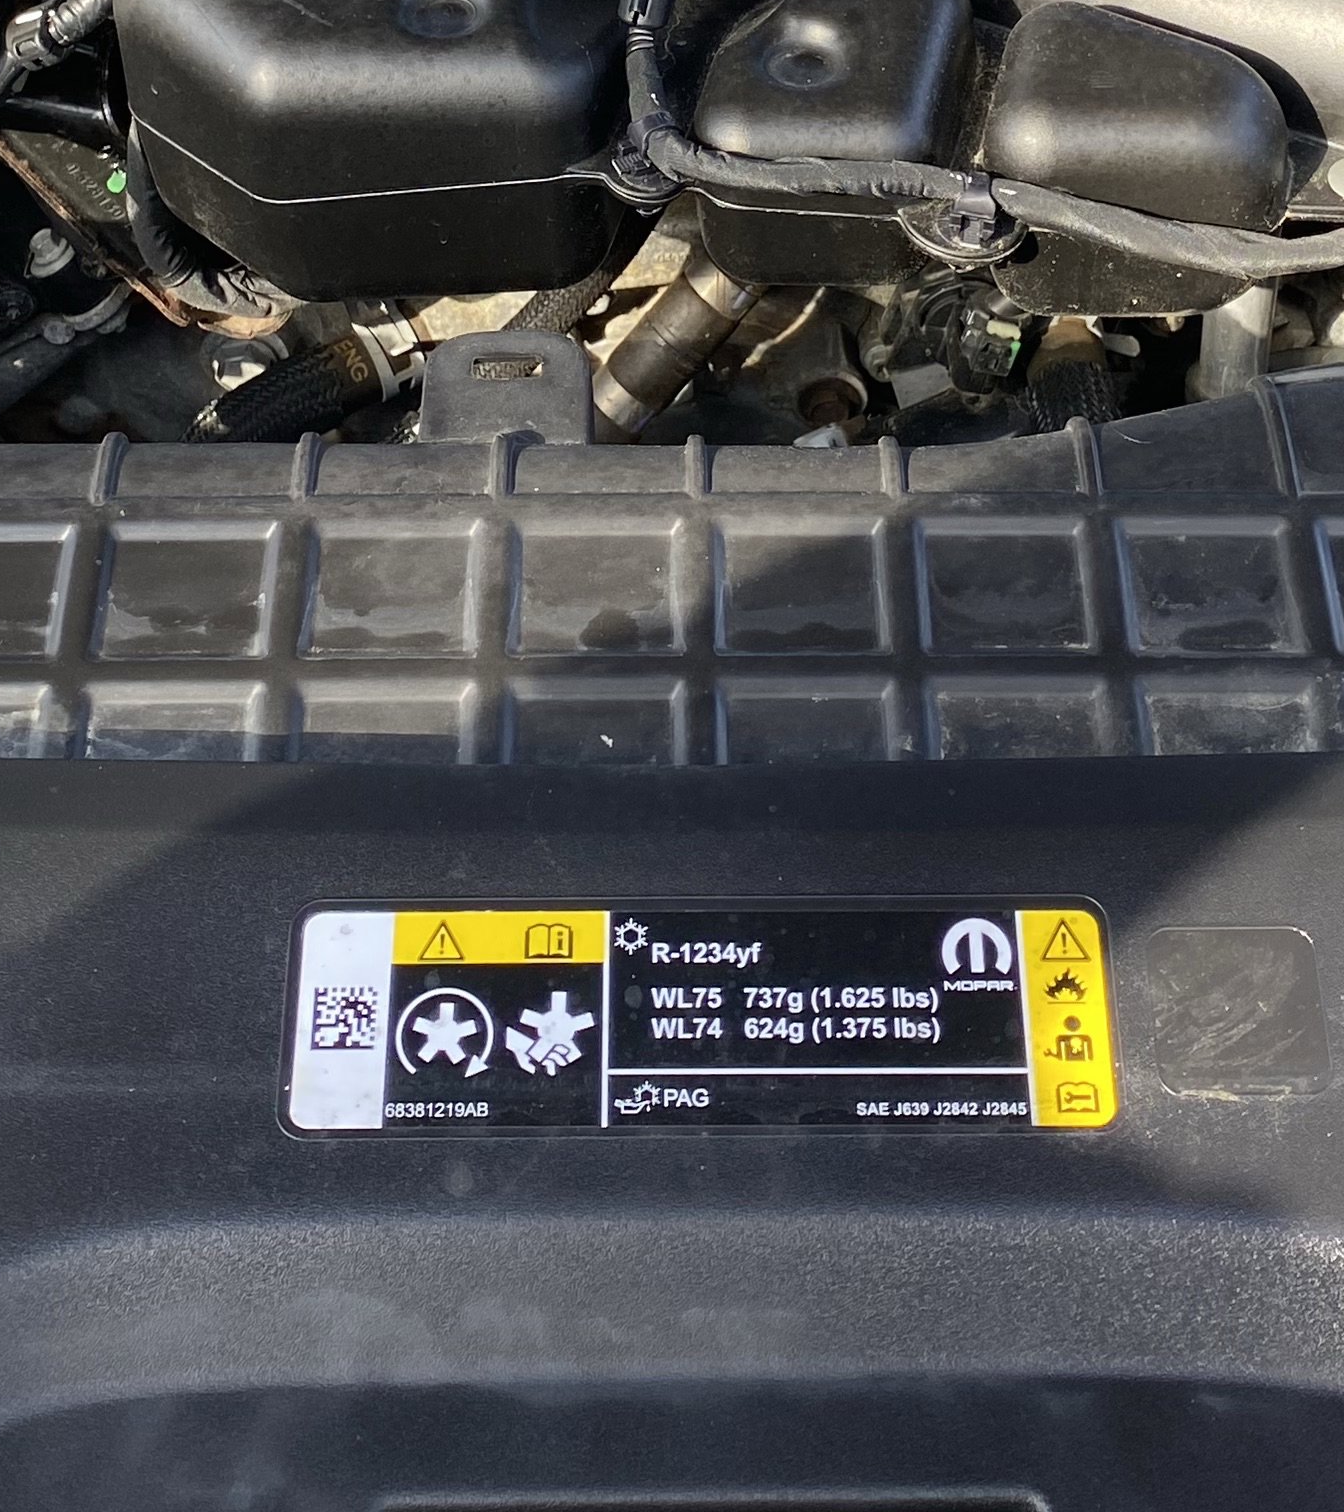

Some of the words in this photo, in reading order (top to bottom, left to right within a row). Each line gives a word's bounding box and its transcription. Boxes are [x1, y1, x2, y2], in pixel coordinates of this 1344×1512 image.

[651, 942, 761, 968] R-1234yf
[944, 980, 1015, 992] MOPAR
[651, 987, 722, 1009] WL75
[744, 987, 803, 1013] 737g
[811, 987, 885, 1013] (1.625
[893, 987, 939, 1013] lbs)
[651, 1018, 723, 1039] WL74
[744, 1018, 804, 1044] 624g
[812, 1017, 886, 1043] (1.375
[894, 1017, 940, 1043] lbs)
[664, 1088, 710, 1108] PAG
[385, 1102, 489, 1118] 68381219AB
[856, 1102, 890, 1115] SAE
[894, 1102, 929, 1115] J639
[933, 1102, 979, 1115] J2842
[983, 1102, 1027, 1115] J2845
